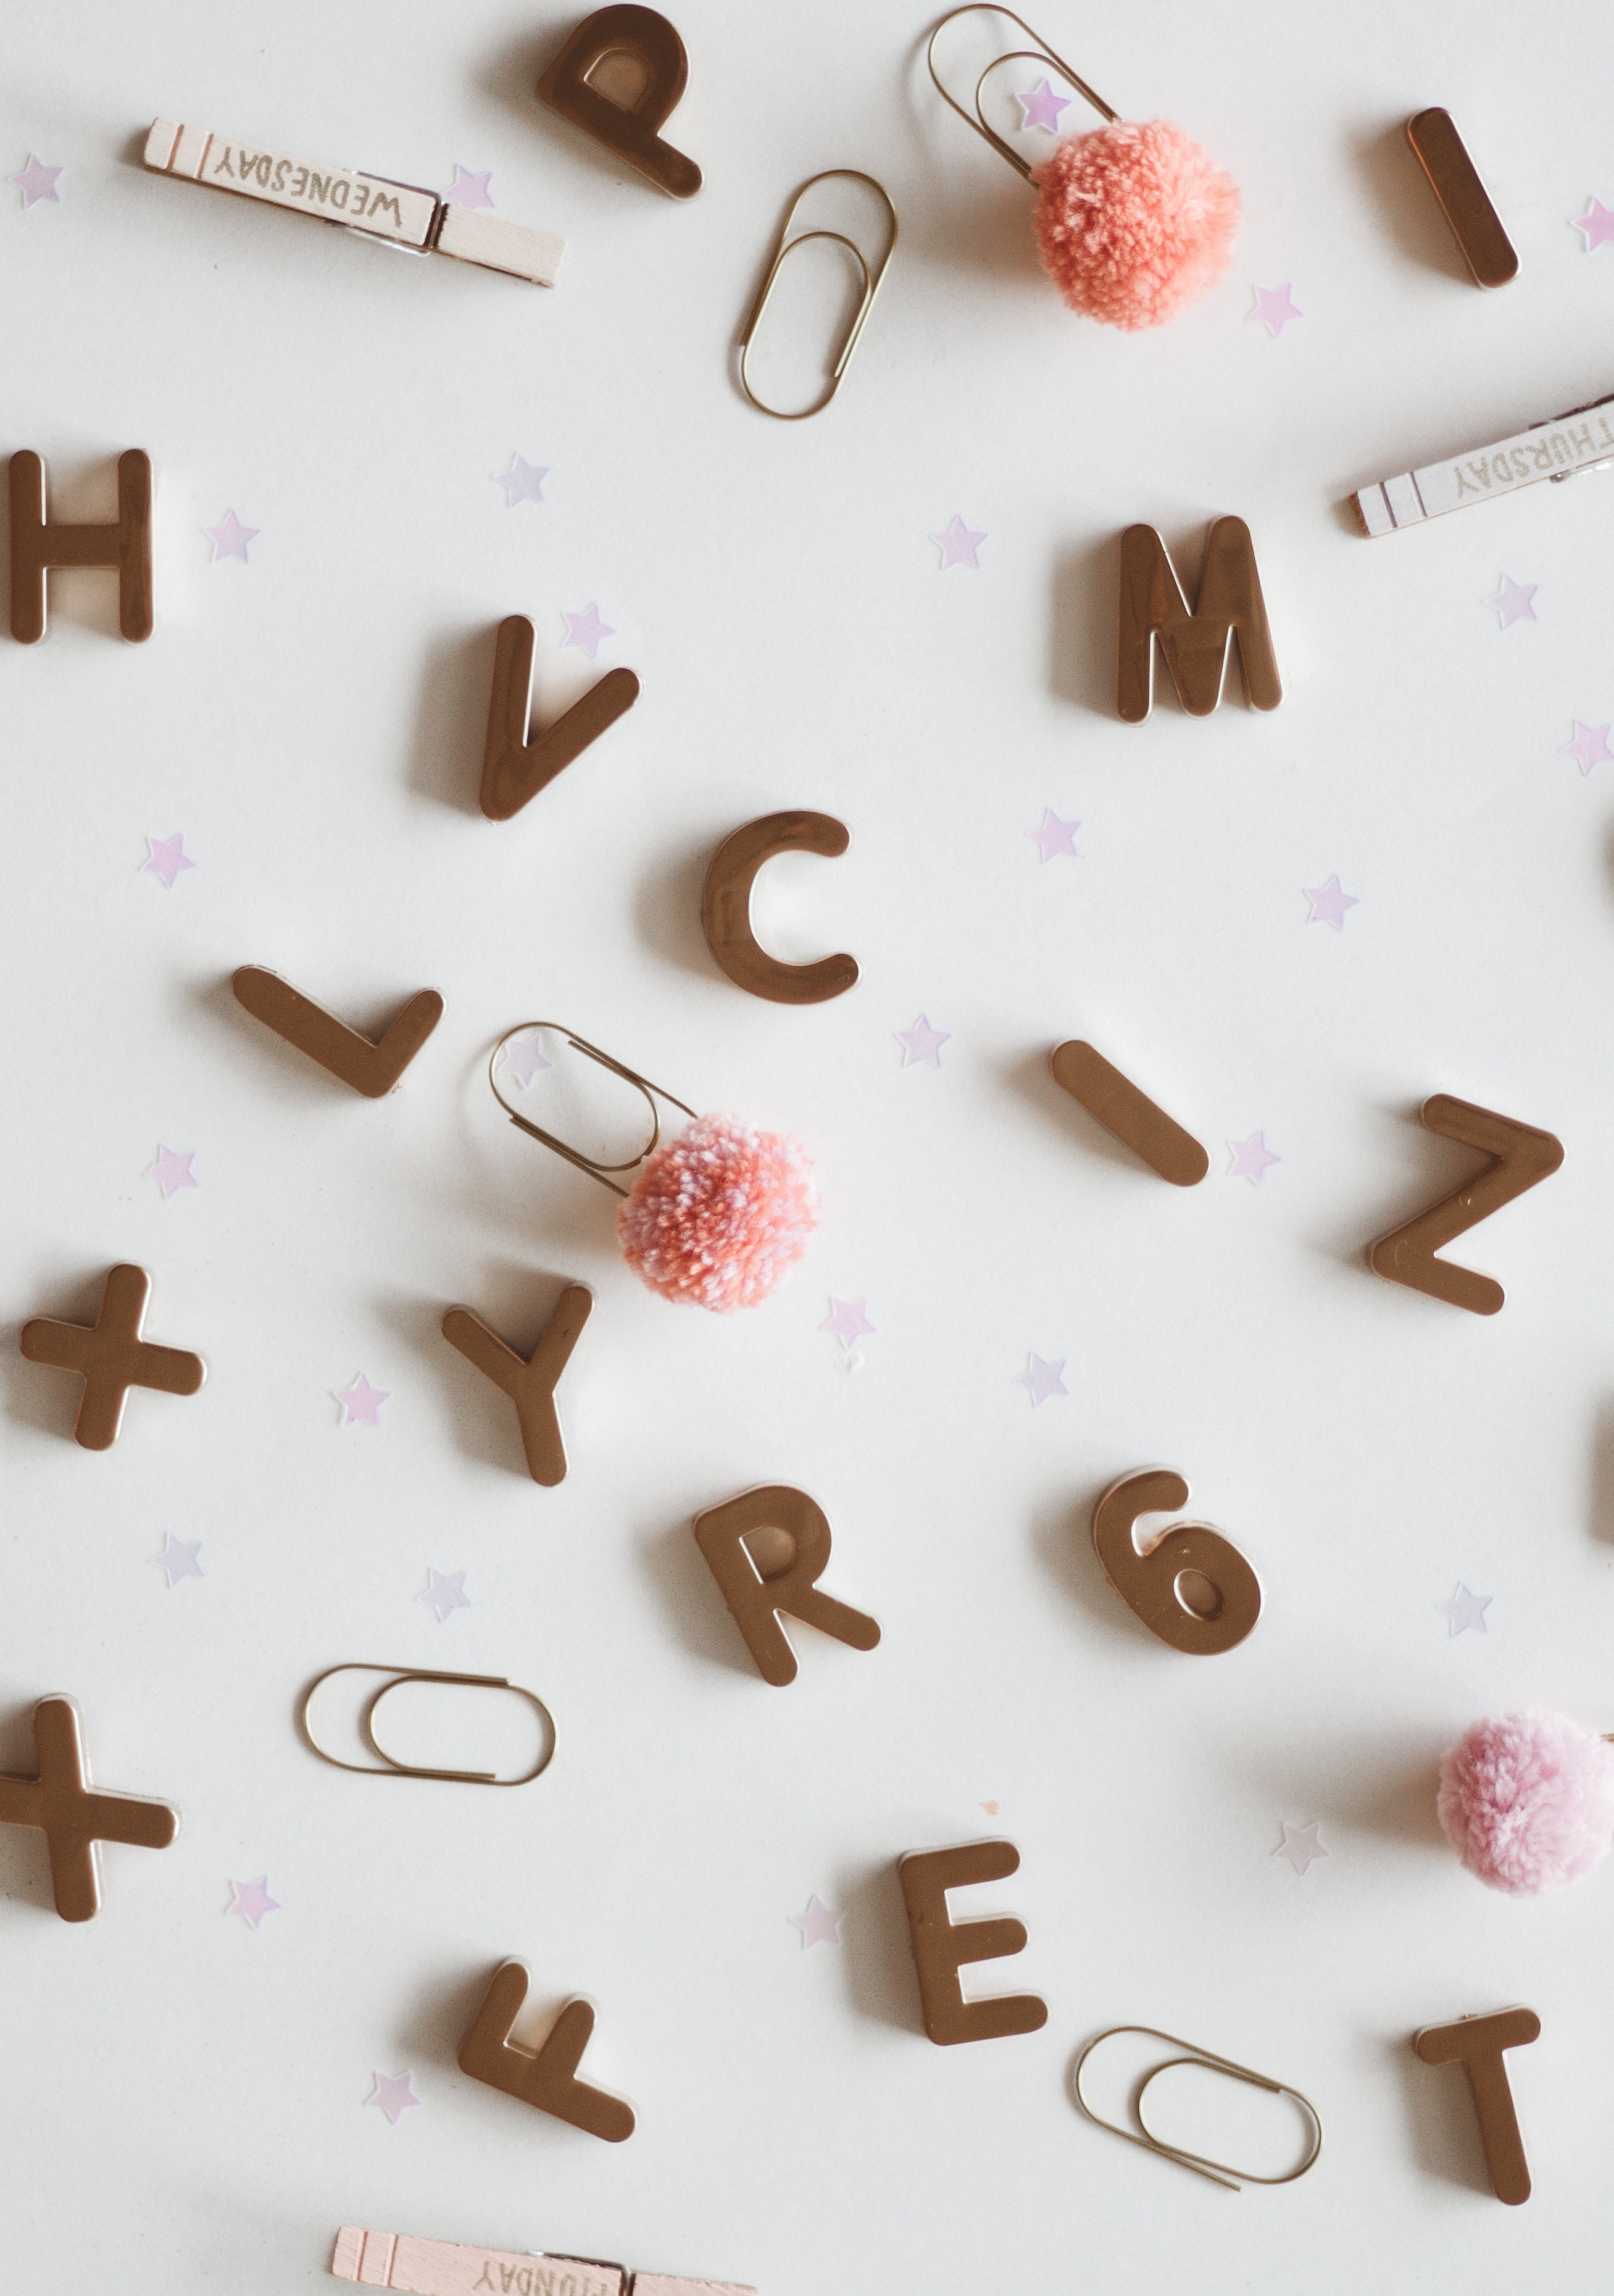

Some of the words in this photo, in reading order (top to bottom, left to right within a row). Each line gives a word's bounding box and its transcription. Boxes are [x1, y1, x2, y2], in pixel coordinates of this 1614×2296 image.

[214, 146, 404, 228] WEDNESDAY
[534, 3, 704, 204] P
[5, 448, 154, 643] H
[1453, 417, 1614, 499] THURSDAY
[479, 614, 639, 820] V
[1116, 514, 1281, 722] M
[700, 809, 862, 1004] C
[232, 964, 443, 1098] L
[1368, 1093, 1564, 1315] Z
[20, 1263, 207, 1451] X
[442, 1282, 596, 1487] Y
[693, 1483, 883, 1685] R
[1092, 1469, 1263, 1656] 6
[0, 1694, 179, 1923] X
[898, 1840, 1050, 2047] E
[458, 1958, 638, 2142] F
[1413, 2006, 1541, 2205] T
